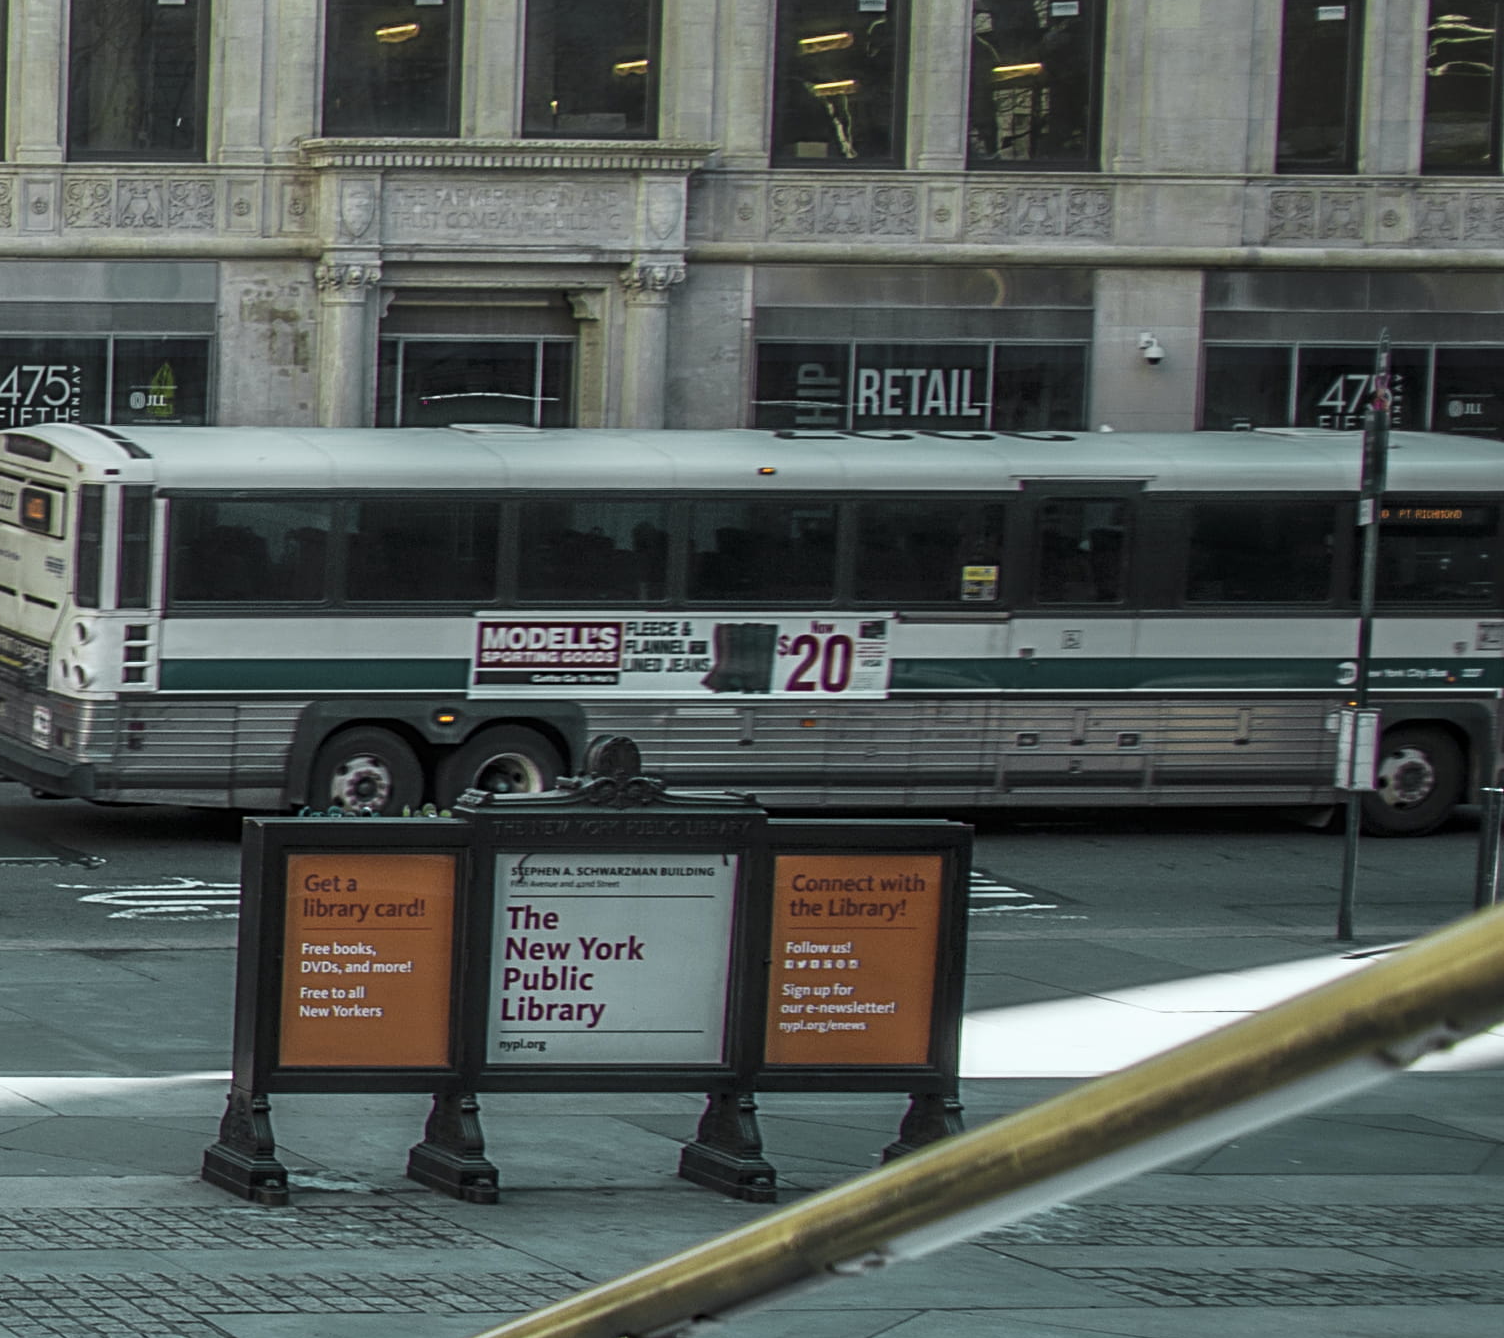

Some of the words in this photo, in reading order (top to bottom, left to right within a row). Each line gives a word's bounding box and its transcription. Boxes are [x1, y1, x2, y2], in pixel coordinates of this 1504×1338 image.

[391, 212, 439, 229] TRUST
[857, 368, 981, 416] RETAIL
[1415, 509, 1463, 519] RICHMOND
[624, 622, 679, 636] FLEECE
[681, 622, 692, 636] &
[811, 621, 836, 633] Now
[481, 627, 617, 650] MODELL'S
[625, 640, 685, 654] FLANNEL
[481, 651, 559, 663] SPORTING
[562, 651, 617, 663] GOODS
[777, 634, 854, 693] $20
[623, 658, 663, 672] LINED
[666, 658, 711, 672] JEANS
[511, 867, 561, 876] STEPHEN
[563, 867, 574, 876] A.
[577, 867, 658, 876] SCHWARZMAN
[660, 867, 715, 877] BUILDING
[304, 874, 343, 892] Get
[346, 878, 358, 892] a
[530, 880, 558, 888] Avenue
[560, 880, 575, 888] and
[597, 880, 620, 888] Street
[792, 874, 874, 892] Connect
[880, 873, 925, 892] with
[303, 898, 369, 923] library
[374, 898, 425, 918] card!
[790, 899, 823, 917] the
[828, 898, 906, 922] Library!
[506, 905, 559, 930] The
[301, 943, 330, 955] Free
[333, 942, 376, 956] books,
[504, 936, 571, 961] New
[578, 935, 645, 961] York
[786, 941, 829, 954] Follow
[832, 942, 851, 954] us!
[301, 961, 342, 974] DVDs,
[345, 961, 370, 973] and
[372, 961, 411, 973] more!
[502, 966, 594, 991] Public
[299, 986, 329, 999] Free
[332, 987, 346, 999] to
[348, 986, 365, 999] all
[782, 983, 810, 999] Sign
[814, 987, 830, 998] up
[833, 983, 854, 996] for
[299, 1005, 329, 1017] New
[332, 1004, 383, 1018] Yorkers
[501, 996, 606, 1029] Library
[781, 1004, 803, 1014] our
[806, 1002, 895, 1014] e-newsletter!
[779, 1020, 866, 1033] nypl.org/enews
[499, 1039, 546, 1052] nypl.org
